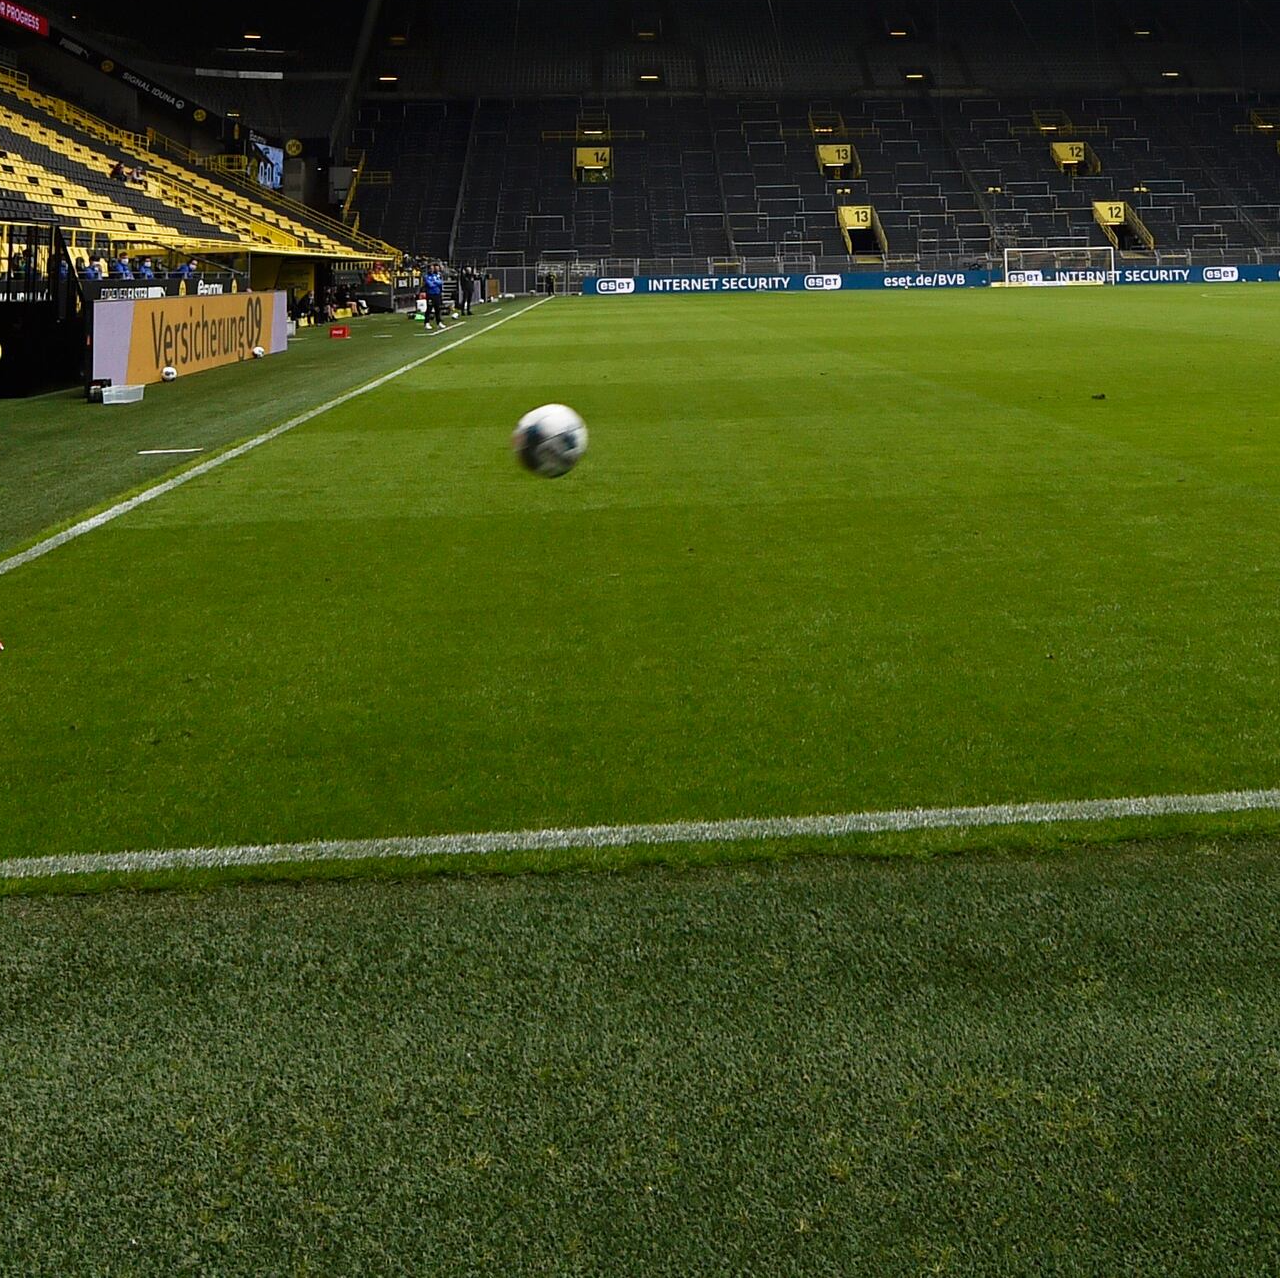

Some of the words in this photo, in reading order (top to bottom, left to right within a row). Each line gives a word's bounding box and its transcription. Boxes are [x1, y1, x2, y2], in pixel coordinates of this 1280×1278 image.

[4, 3, 41, 32] PROGRESS
[594, 152, 607, 163] 14
[835, 148, 849, 160] 13
[1069, 146, 1082, 157] 12
[854, 210, 869, 223] 13
[1108, 206, 1122, 219] 12
[883, 273, 966, 288] eset.de/BVB
[1055, 270, 1123, 283] INTERNET
[1124, 269, 1191, 282] SECURITY
[647, 277, 719, 291] INTERNET
[721, 276, 791, 290] SECURITY
